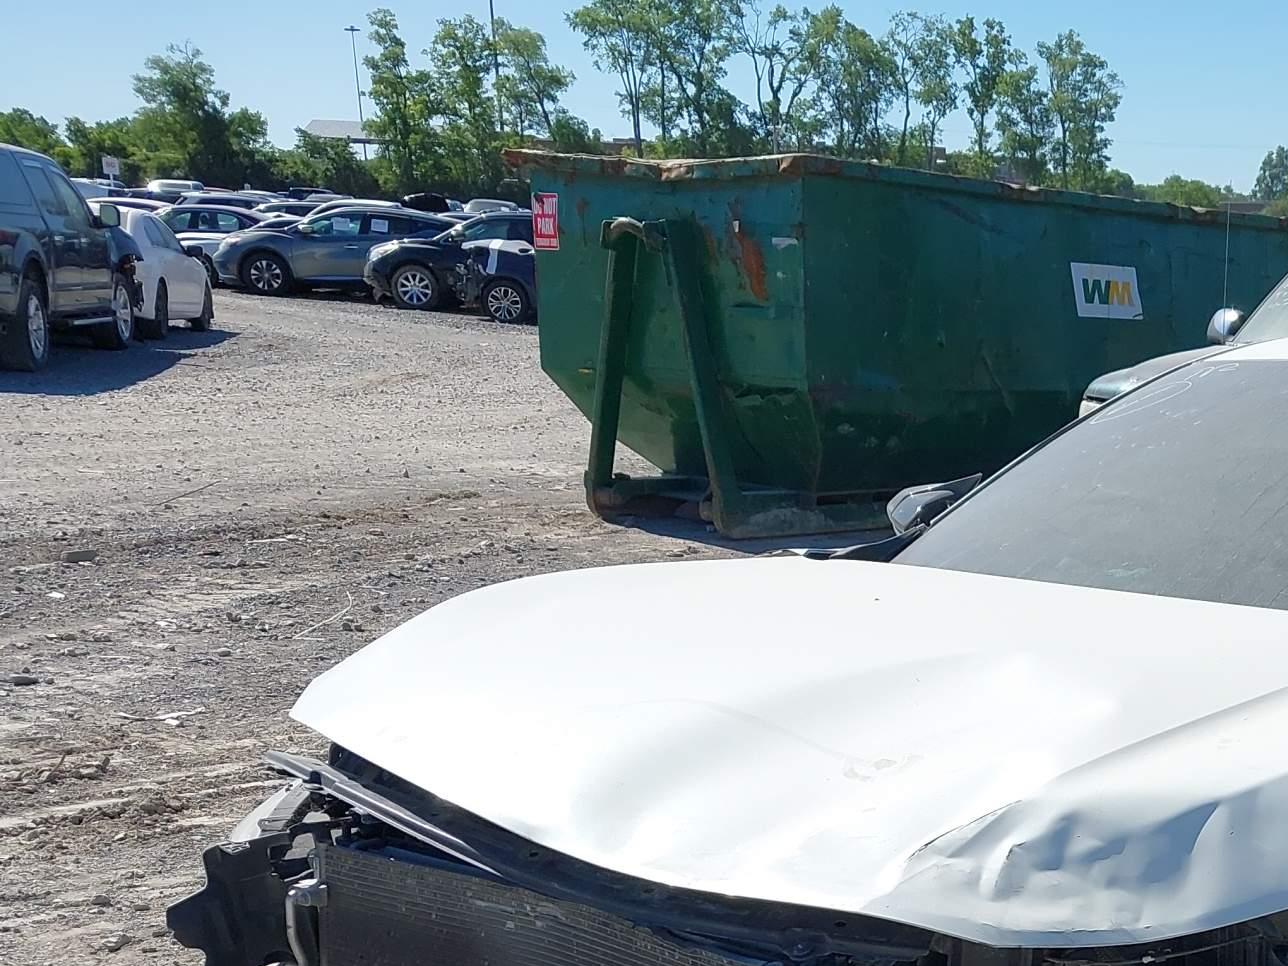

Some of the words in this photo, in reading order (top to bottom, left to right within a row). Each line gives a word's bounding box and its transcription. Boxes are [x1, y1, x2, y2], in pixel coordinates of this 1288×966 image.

[543, 198, 556, 215] NOT
[537, 217, 555, 235] PARK
[1082, 278, 1136, 307] WM
